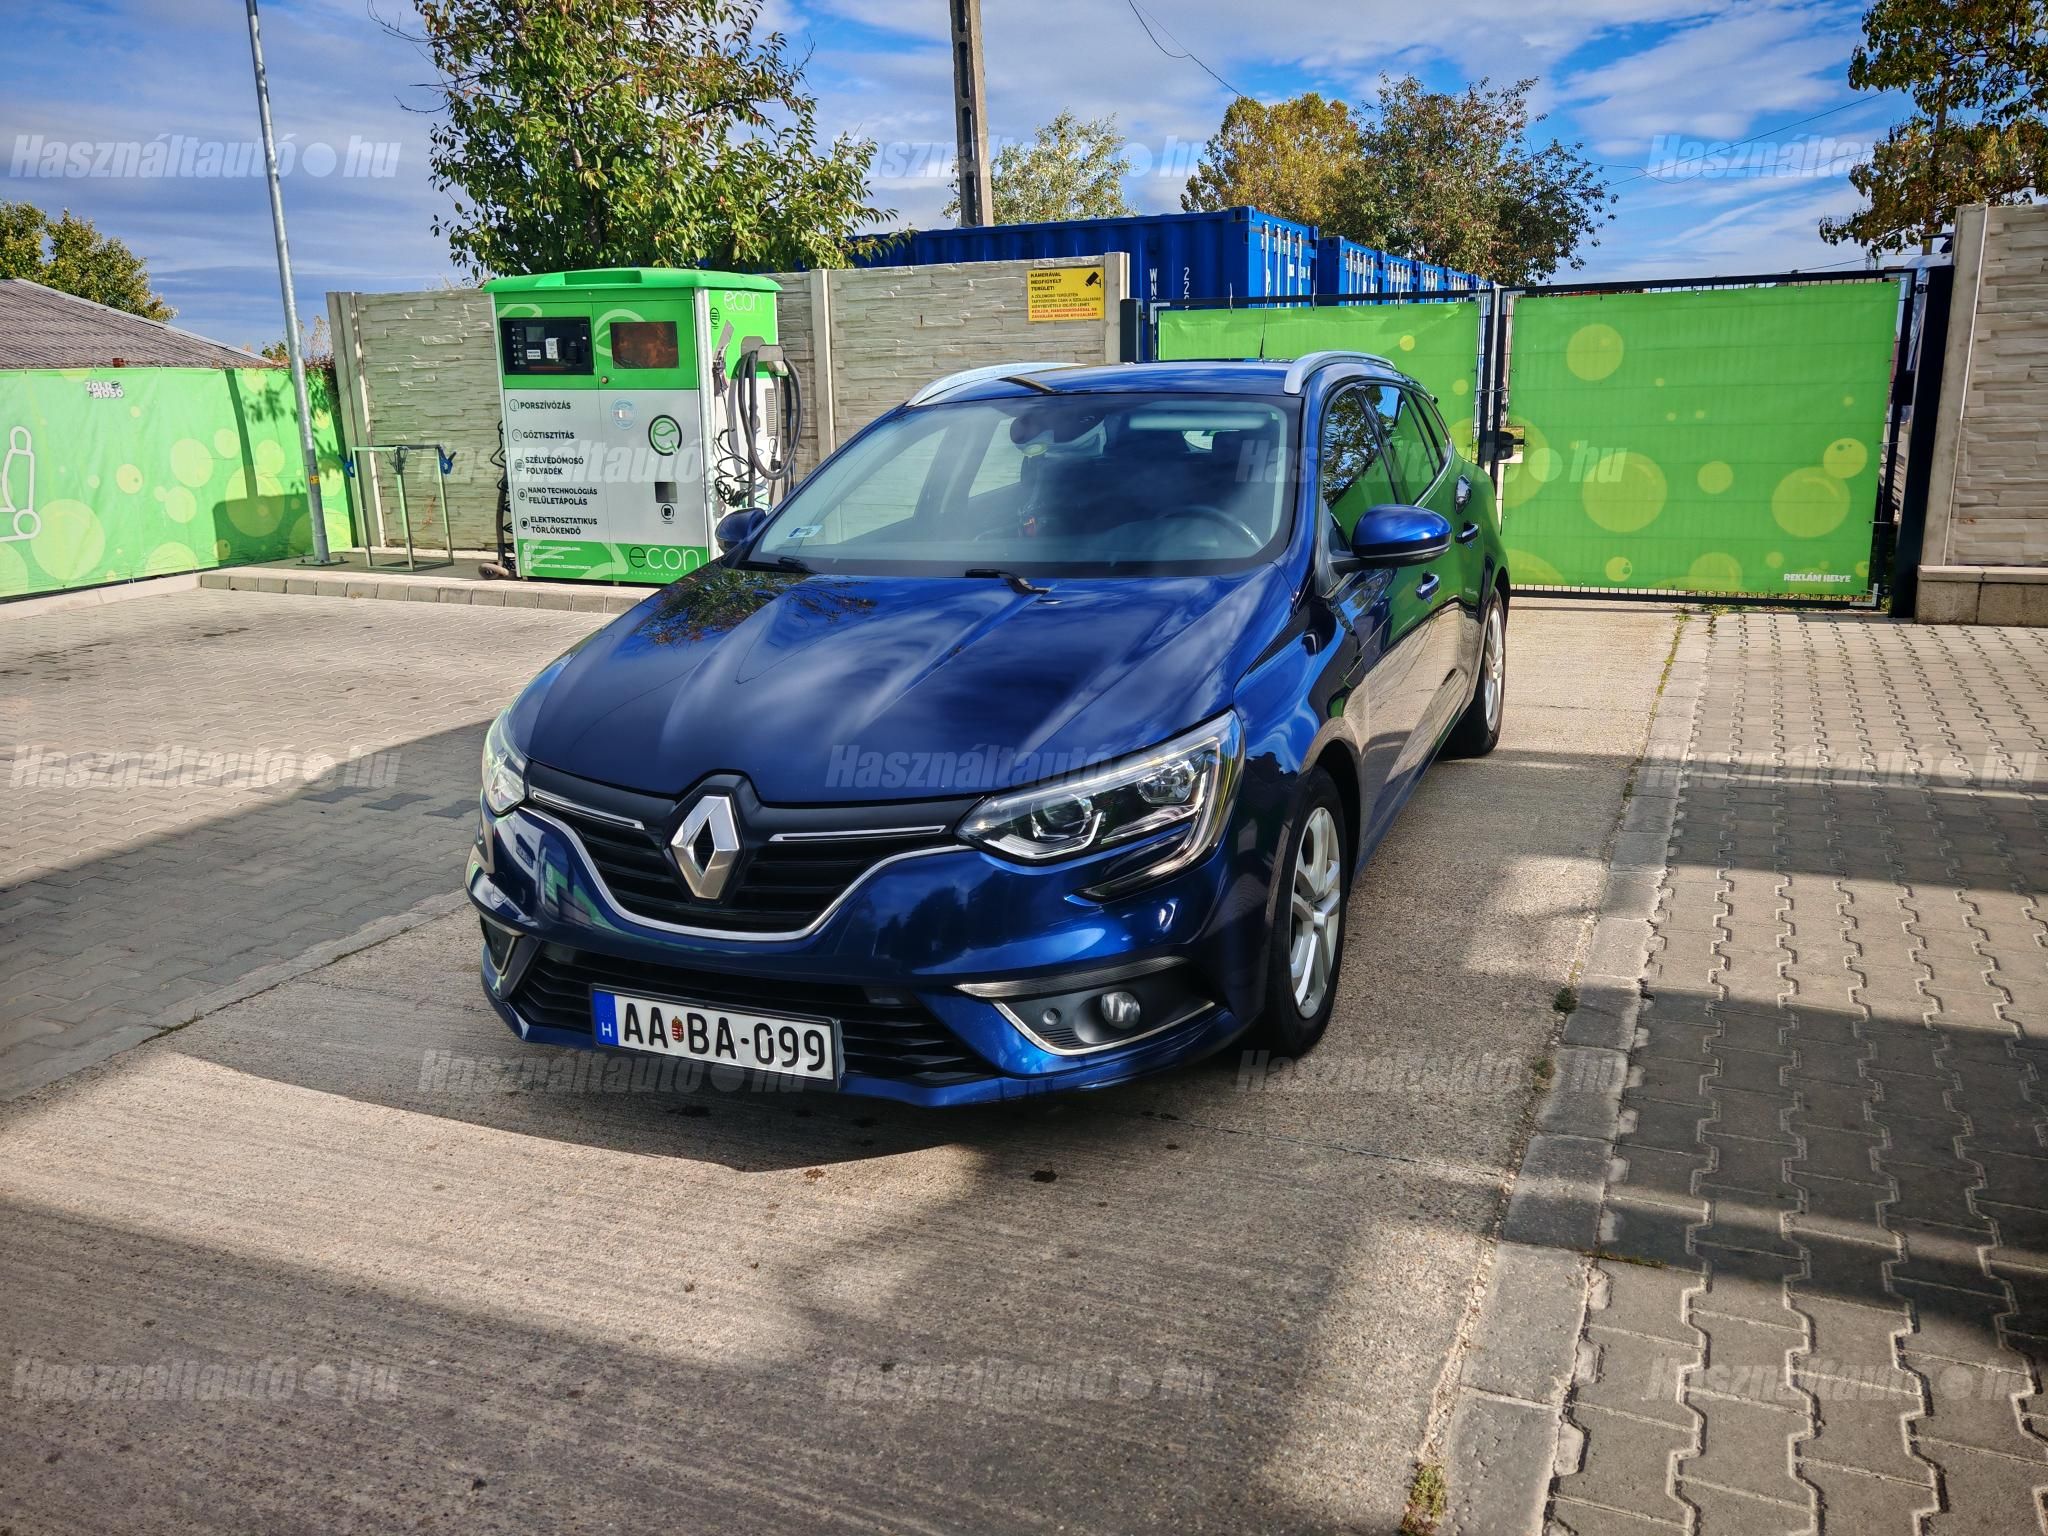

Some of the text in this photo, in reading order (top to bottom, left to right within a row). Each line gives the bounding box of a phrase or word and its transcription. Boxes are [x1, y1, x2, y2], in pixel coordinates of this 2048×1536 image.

[526, 466, 563, 475] FOLYADÉK
[527, 486, 547, 494] NANO
[530, 516, 598, 526] ELEKTROSZTATIKUS
[629, 546, 700, 571] econ
[1783, 572, 1852, 583] REKLÁM HELYE
[601, 1021, 612, 1038] H
